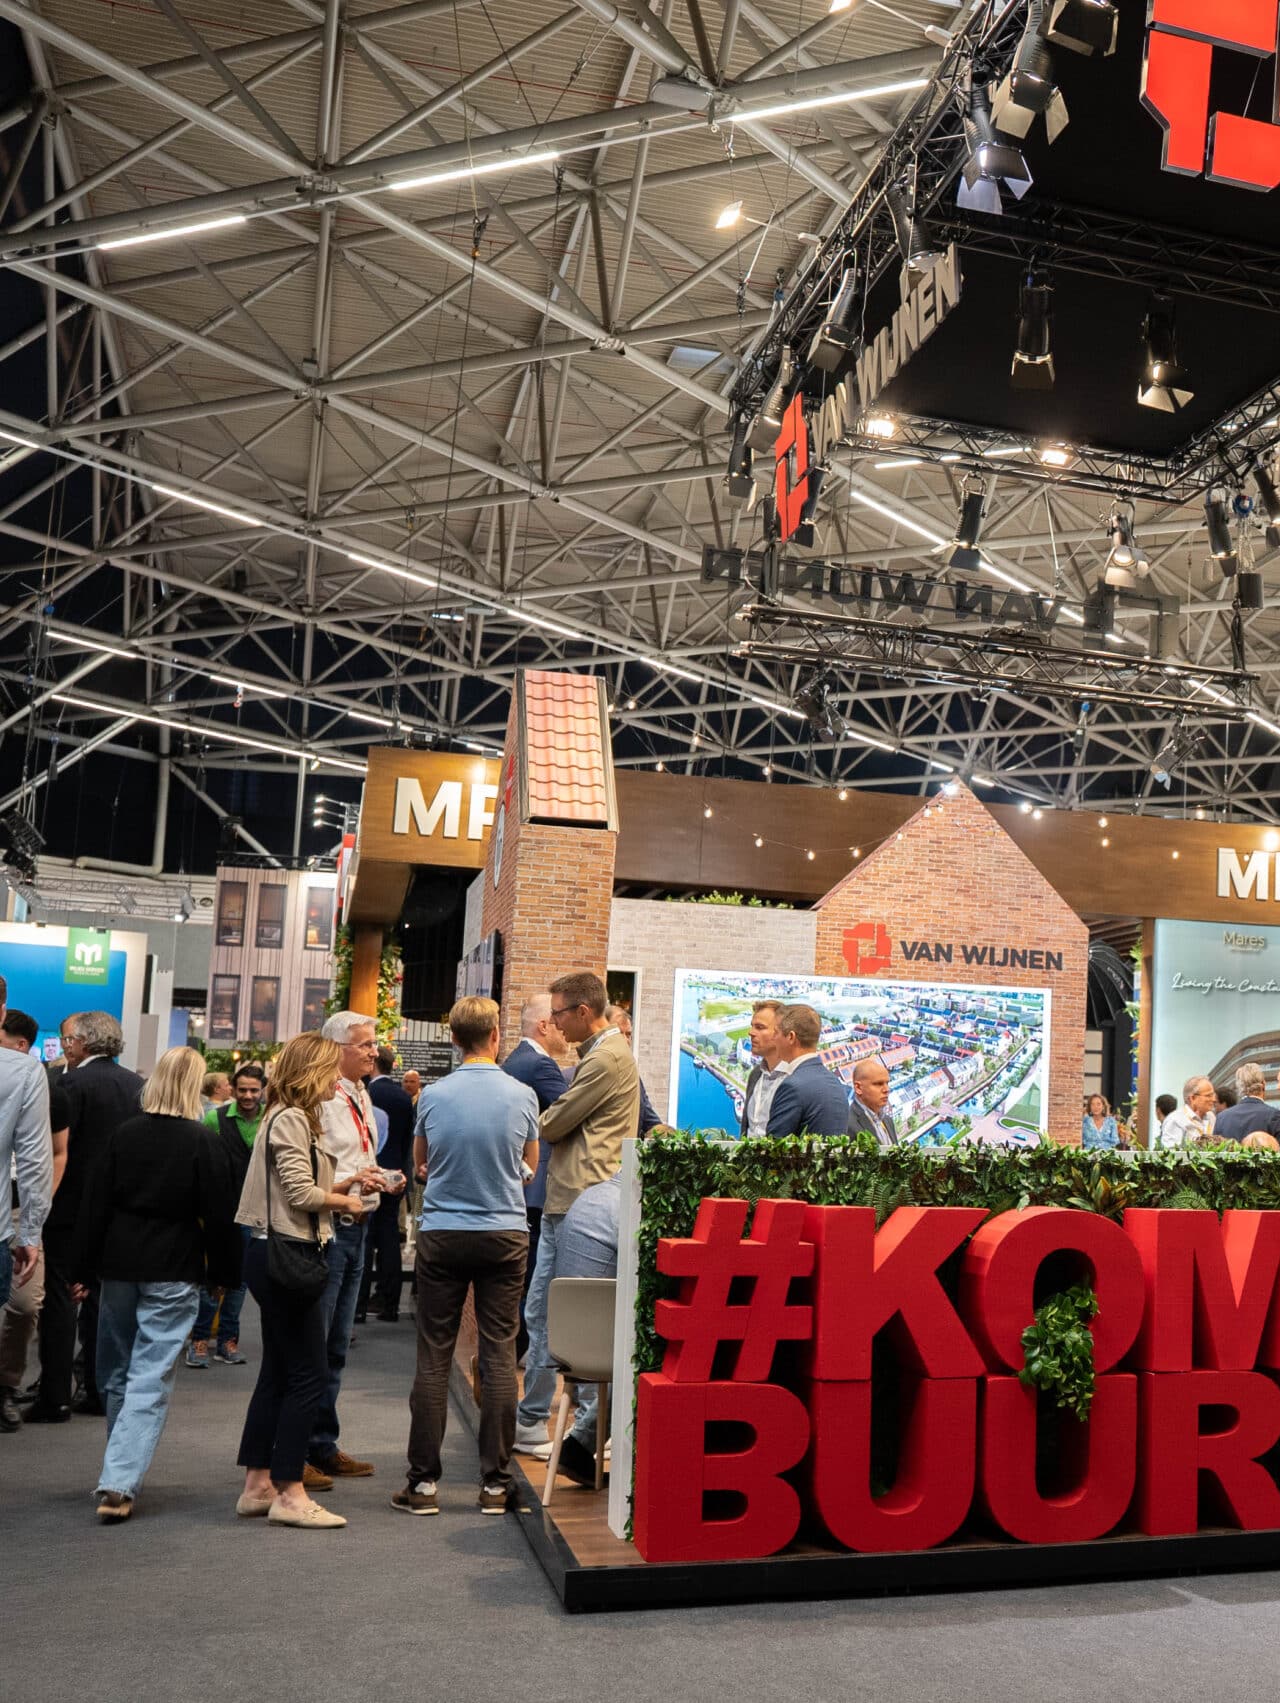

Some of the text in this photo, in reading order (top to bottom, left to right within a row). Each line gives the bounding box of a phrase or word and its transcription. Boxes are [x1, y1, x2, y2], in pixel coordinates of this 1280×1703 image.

[811, 242, 963, 464] VAN WIJNEN
[1223, 930, 1266, 948] Mares
[899, 940, 1064, 972] VAN WIJNEN
[1171, 972, 1213, 995] Living
[1214, 976, 1237, 989] the
